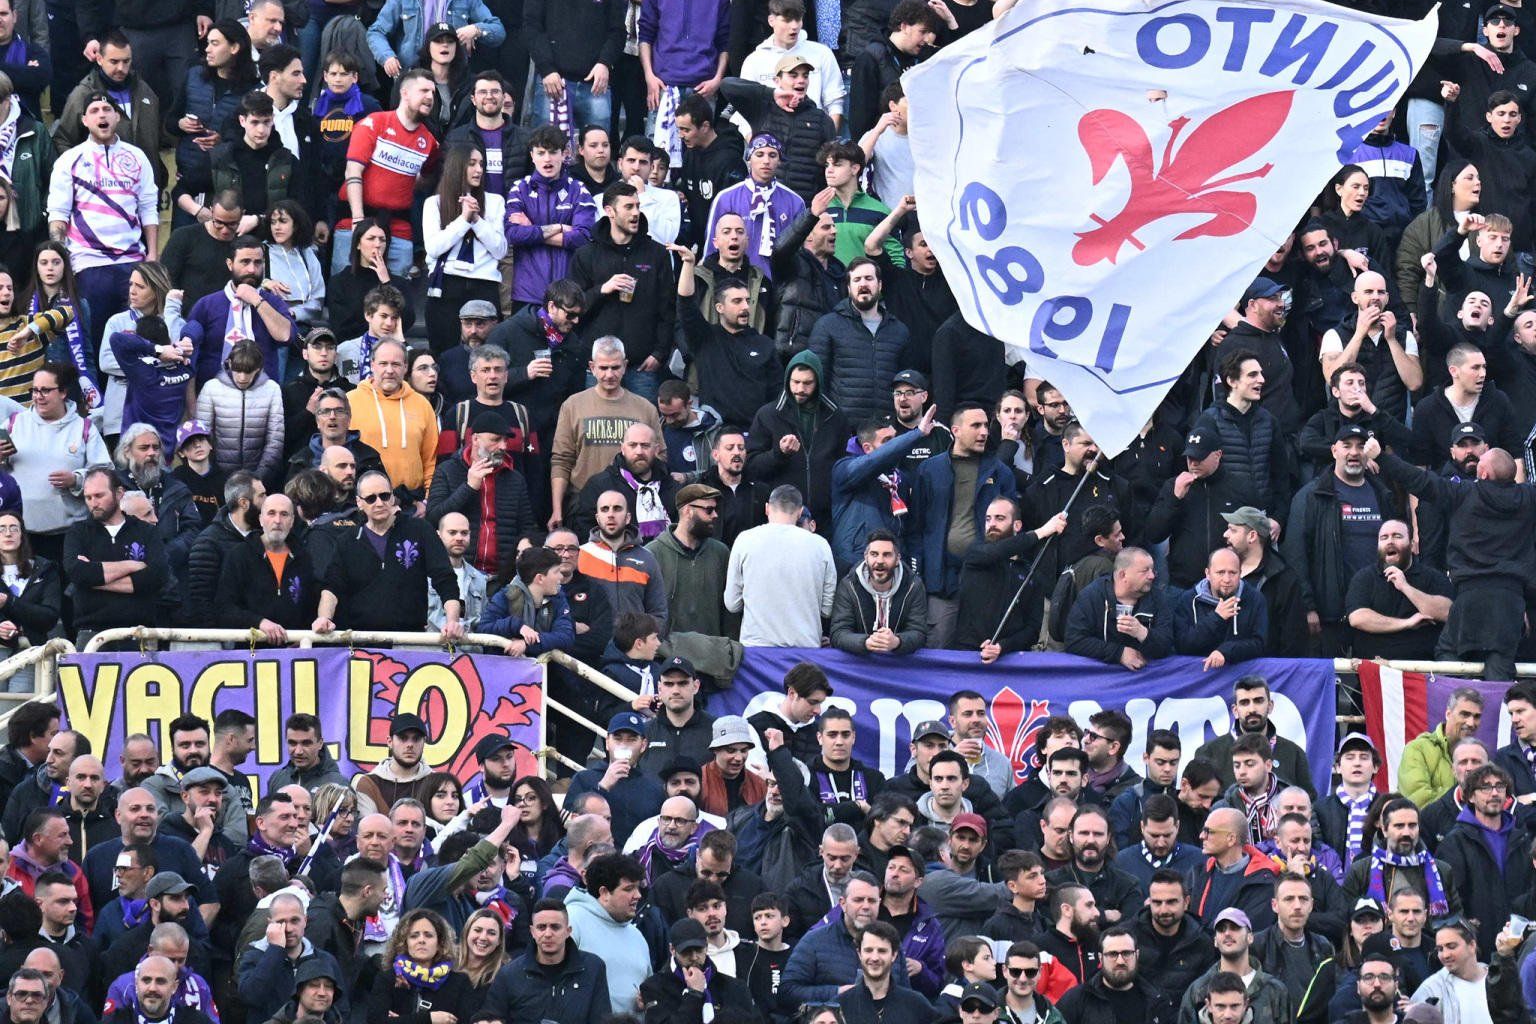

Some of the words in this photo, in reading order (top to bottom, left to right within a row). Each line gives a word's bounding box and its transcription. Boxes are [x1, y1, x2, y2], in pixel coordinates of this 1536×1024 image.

[320, 119, 354, 132] PUMA
[586, 418, 635, 439] JACK&JON
[772, 969, 780, 995] NIKE
